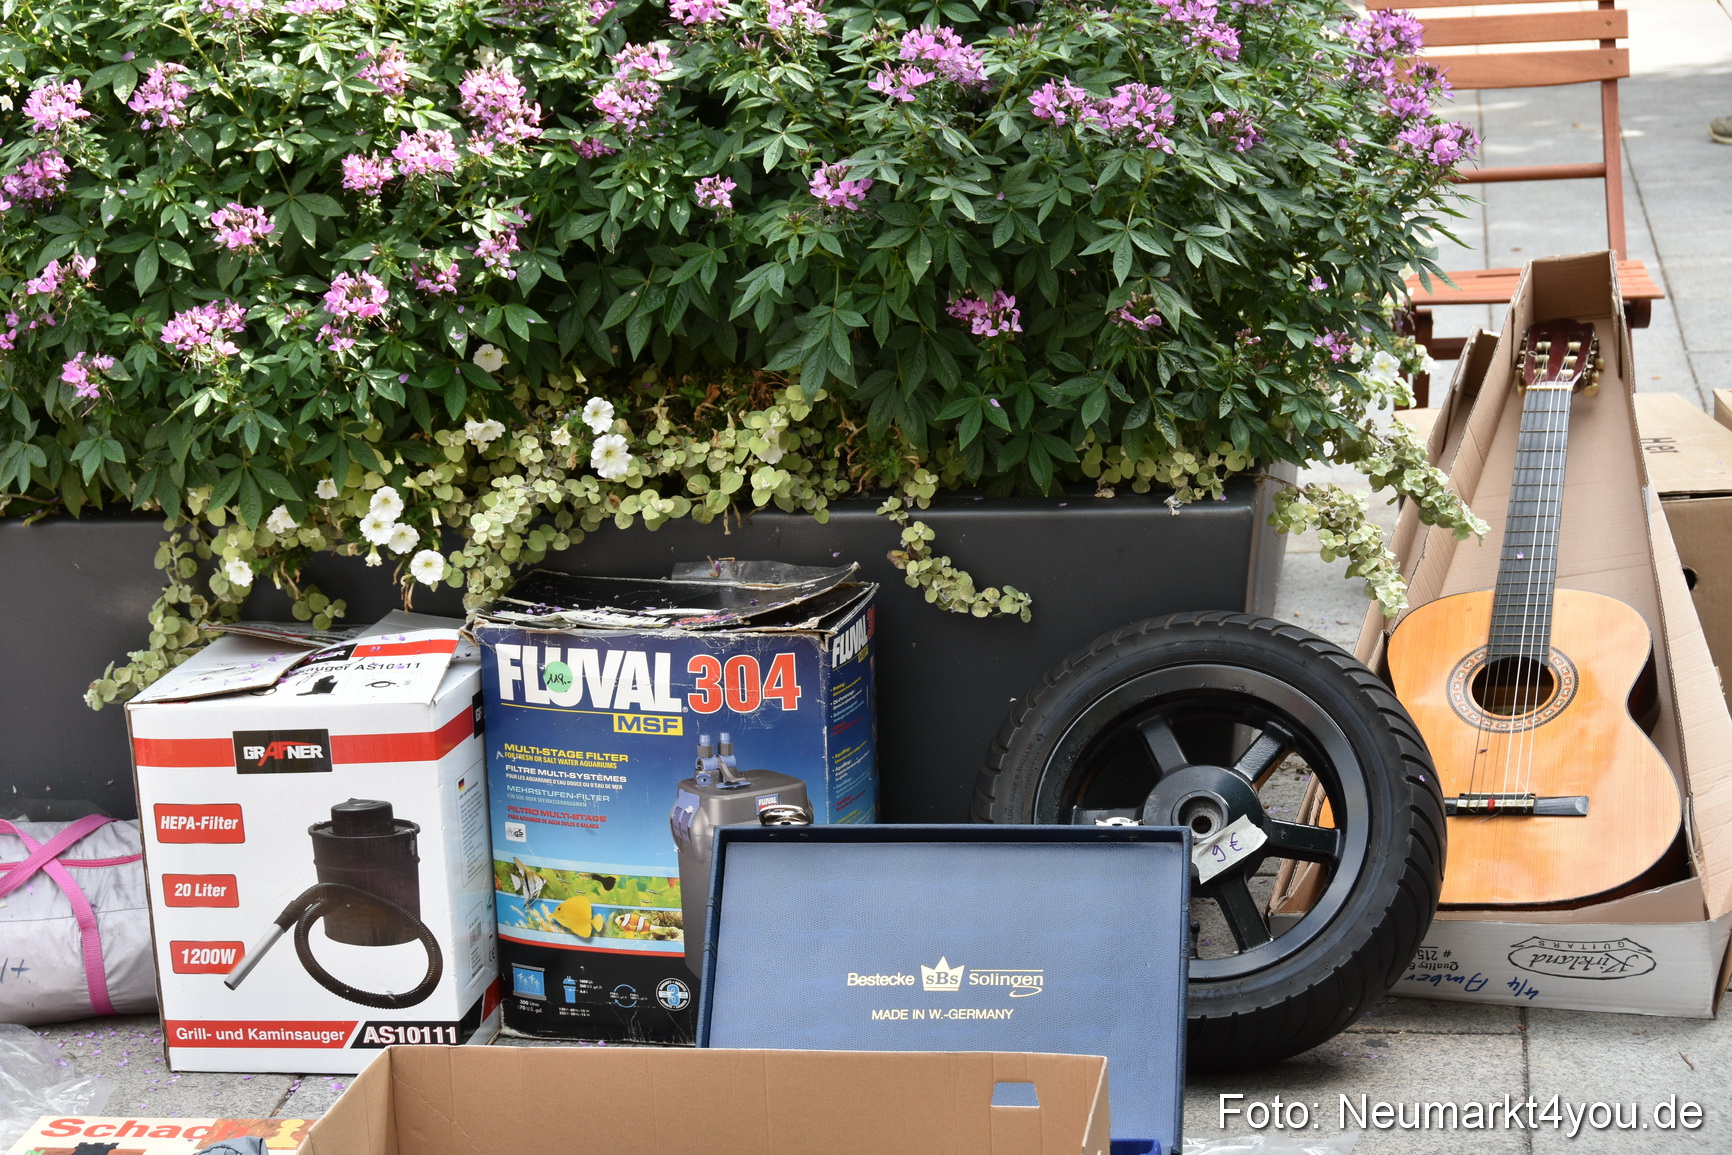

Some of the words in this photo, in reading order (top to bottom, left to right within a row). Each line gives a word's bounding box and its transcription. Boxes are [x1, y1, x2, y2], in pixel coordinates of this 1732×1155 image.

[832, 614, 869, 669] FLUVAL
[495, 644, 682, 713] FLUVAL
[687, 653, 801, 714] 304
[617, 717, 679, 734] MSF
[243, 740, 323, 766] GRAFNER
[504, 743, 584, 759] MULTI-STAGE
[585, 752, 629, 763] FILTER
[504, 751, 515, 759] FOR
[515, 753, 533, 762] FRESH
[534, 755, 542, 763] OR
[543, 756, 557, 765] SALT
[557, 758, 578, 767] WATER
[580, 760, 617, 769] AQUARIUMS
[505, 764, 537, 775] FILTRE
[538, 769, 627, 783] MULTI-SYSTÈMES
[526, 776, 553, 784] AQUARIUMS
[506, 785, 610, 802] MEHRSTUFEN-FILTER
[508, 805, 539, 816] FILTRO
[541, 810, 607, 822] MULTI-STAGE
[160, 815, 239, 831] HEPA-Filter
[1212, 845, 1226, 862] 9
[1229, 832, 1243, 851] €
[174, 884, 191, 897] 20
[193, 884, 227, 897] Liter
[1538, 940, 1625, 950] GUITARS
[181, 948, 237, 965] 1200W
[1443, 949, 1452, 959] #
[1422, 960, 1459, 971] Quality
[1528, 952, 1639, 974] Kirkland
[847, 972, 915, 986] Bestecke
[926, 971, 959, 985] sBs
[969, 971, 1044, 996] Solingen
[667, 984, 680, 1006] 3
[871, 1009, 909, 1020] MADE
[912, 1009, 925, 1020] IN
[928, 1008, 1014, 1020] W.-GERMANY
[176, 1027, 212, 1040] Grill-
[215, 1028, 243, 1041] und
[247, 1028, 345, 1043] Kaminsauger
[363, 1026, 457, 1044] AS10111
[40, 1118, 250, 1140] Schach
